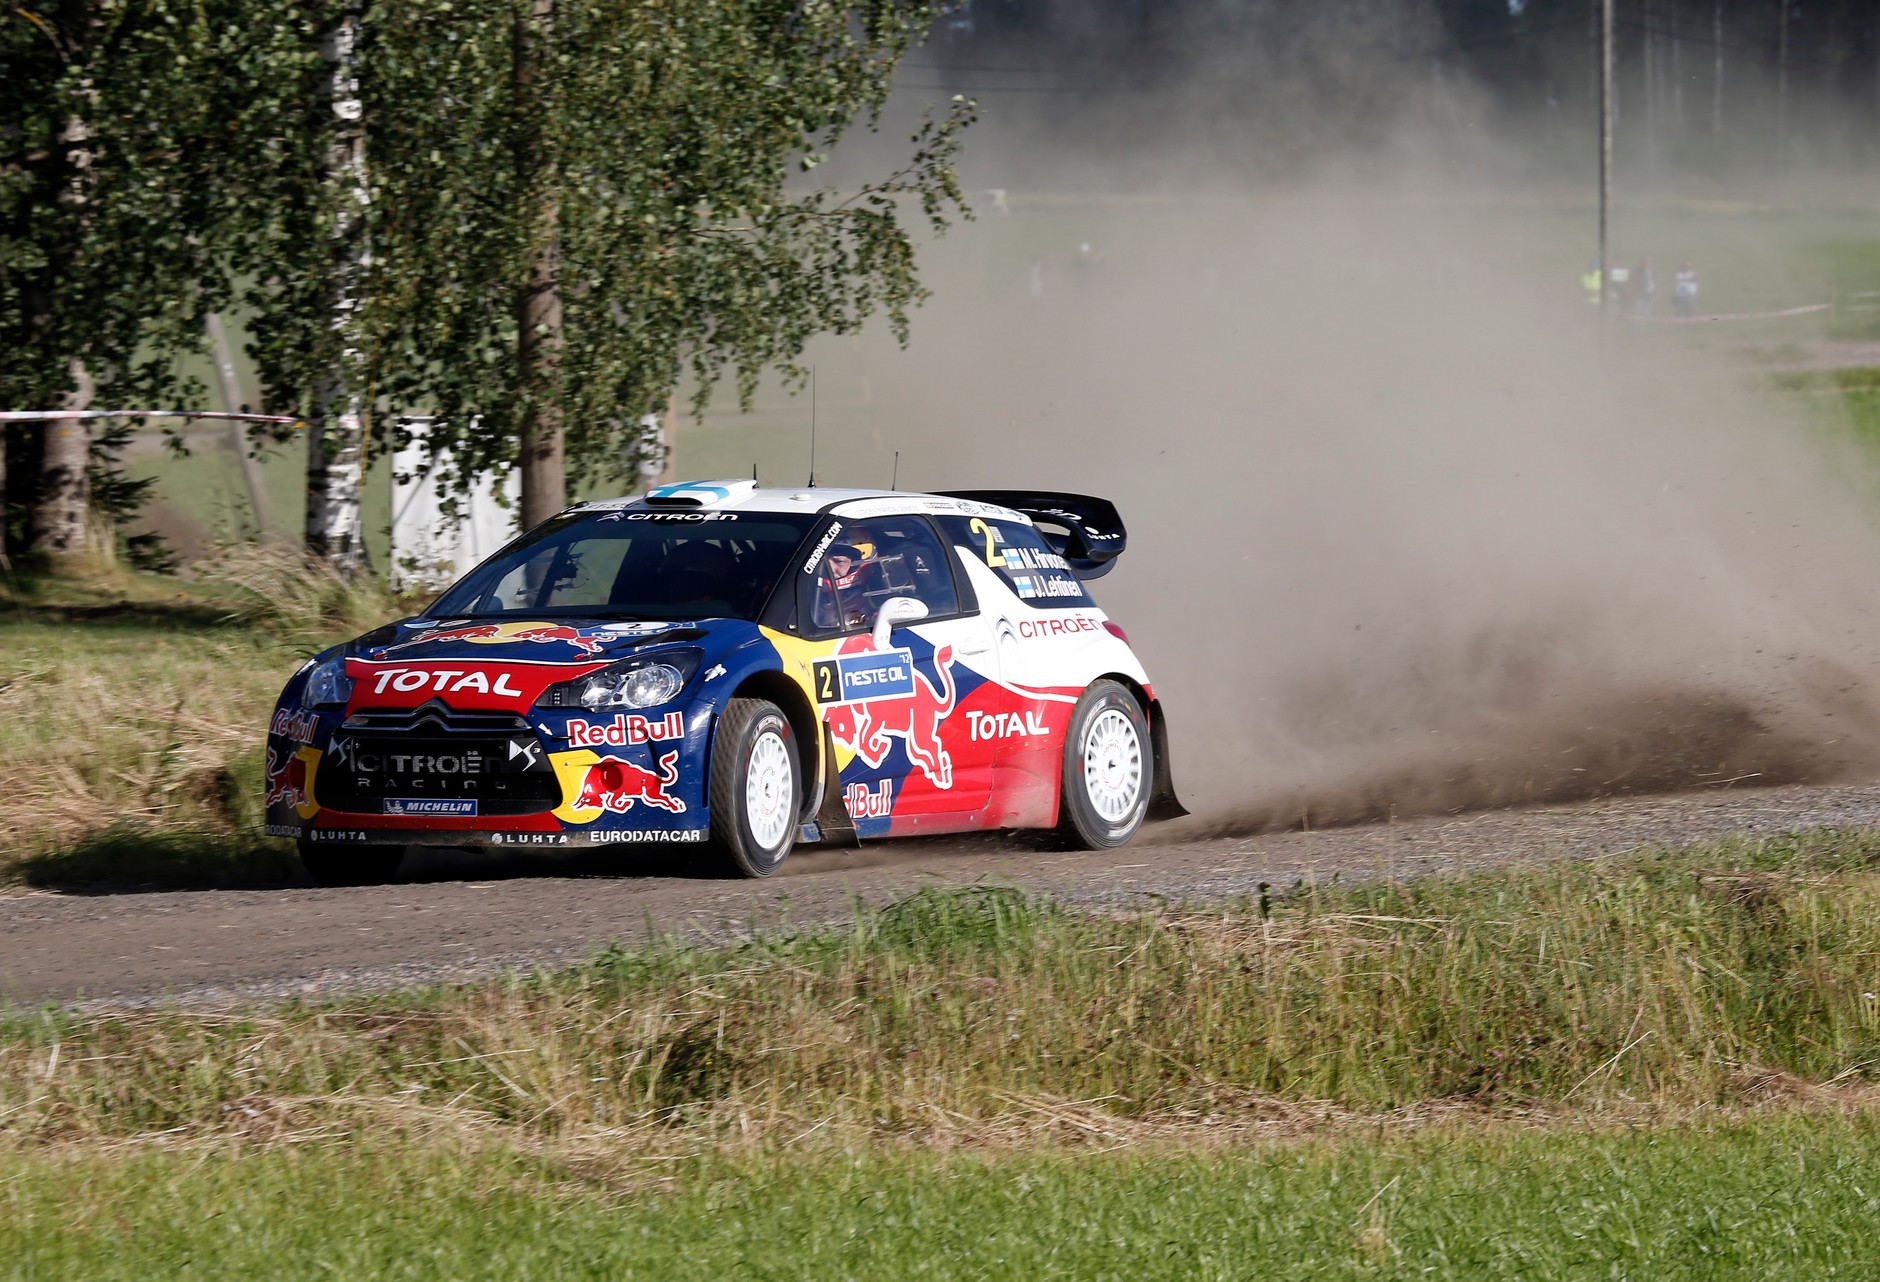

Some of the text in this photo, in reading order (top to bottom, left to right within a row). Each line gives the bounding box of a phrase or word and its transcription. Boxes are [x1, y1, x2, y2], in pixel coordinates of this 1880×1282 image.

[627, 511, 738, 521] CITROËN
[969, 518, 1007, 568] 2
[1020, 613, 1104, 638] CITROËN
[373, 668, 523, 698] TOTAL
[820, 666, 833, 699] 2
[844, 666, 908, 688] NESTE OIL
[966, 710, 1050, 741] TOTAL
[406, 801, 473, 813] MICHELIN
[320, 831, 366, 840] LUHTA
[506, 834, 568, 844] LUHTA
[590, 830, 700, 843] EURODATACAR
